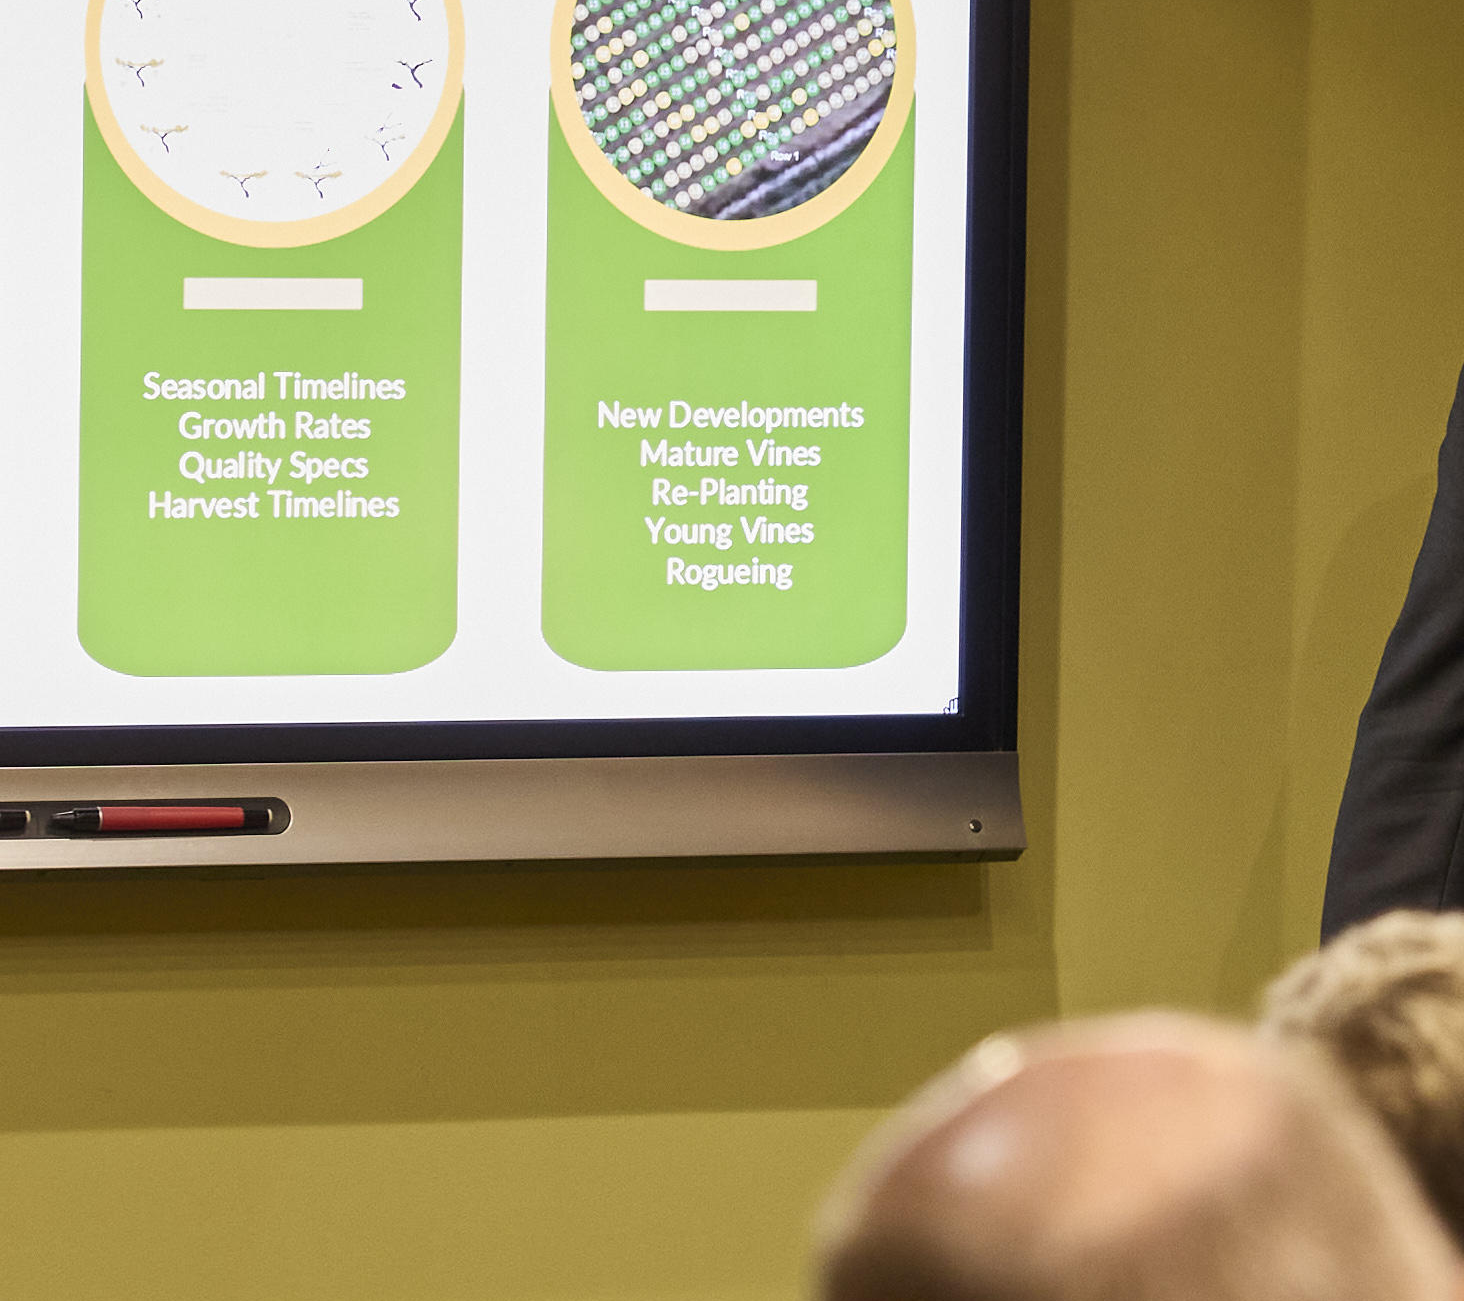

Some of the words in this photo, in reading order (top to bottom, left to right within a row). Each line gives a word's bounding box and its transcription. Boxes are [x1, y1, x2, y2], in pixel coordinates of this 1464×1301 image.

[142, 371, 266, 401] Seasonal
[272, 371, 407, 401] Timelines
[177, 410, 287, 440] Growth
[294, 410, 372, 440] Rates
[597, 399, 664, 429] New
[668, 399, 865, 435] Developments
[178, 450, 283, 485] Quality
[288, 450, 370, 485] Specs
[639, 438, 740, 467] Mature
[745, 438, 822, 467] Vines
[148, 490, 261, 519] Harvest
[266, 489, 401, 519] Timelines
[651, 476, 809, 512] Re-Planting
[643, 515, 734, 551] Young
[739, 515, 815, 545] Vines
[666, 555, 794, 592] Rogueing
